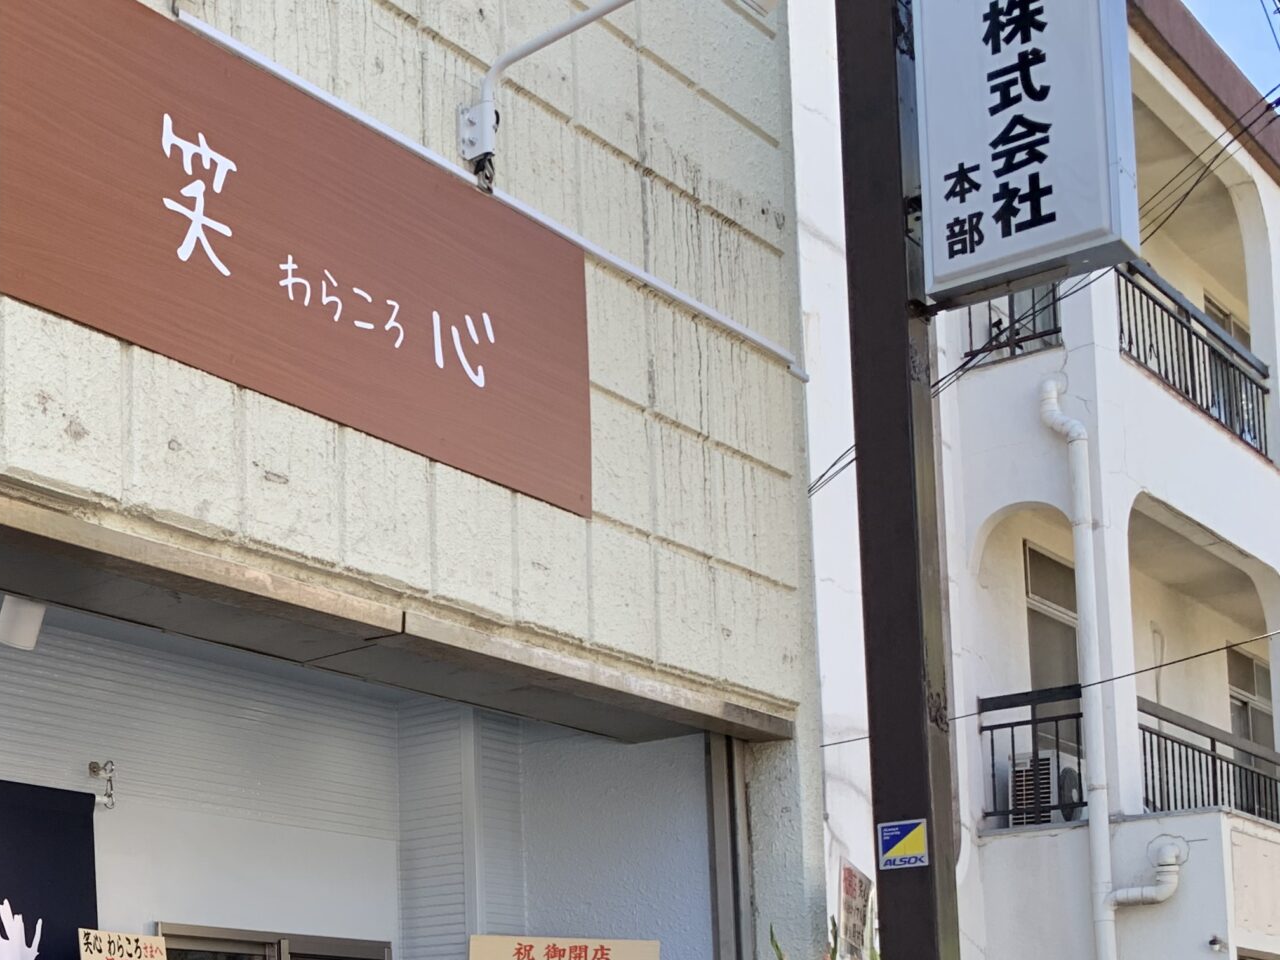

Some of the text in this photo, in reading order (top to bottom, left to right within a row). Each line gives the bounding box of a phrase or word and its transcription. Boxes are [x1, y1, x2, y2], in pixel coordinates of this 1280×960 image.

[982, 0, 1056, 238] 株式会社
[161, 112, 496, 389] 笑 わらころ 心
[943, 161, 986, 260] 本部
[883, 856, 925, 867] ALSOK
